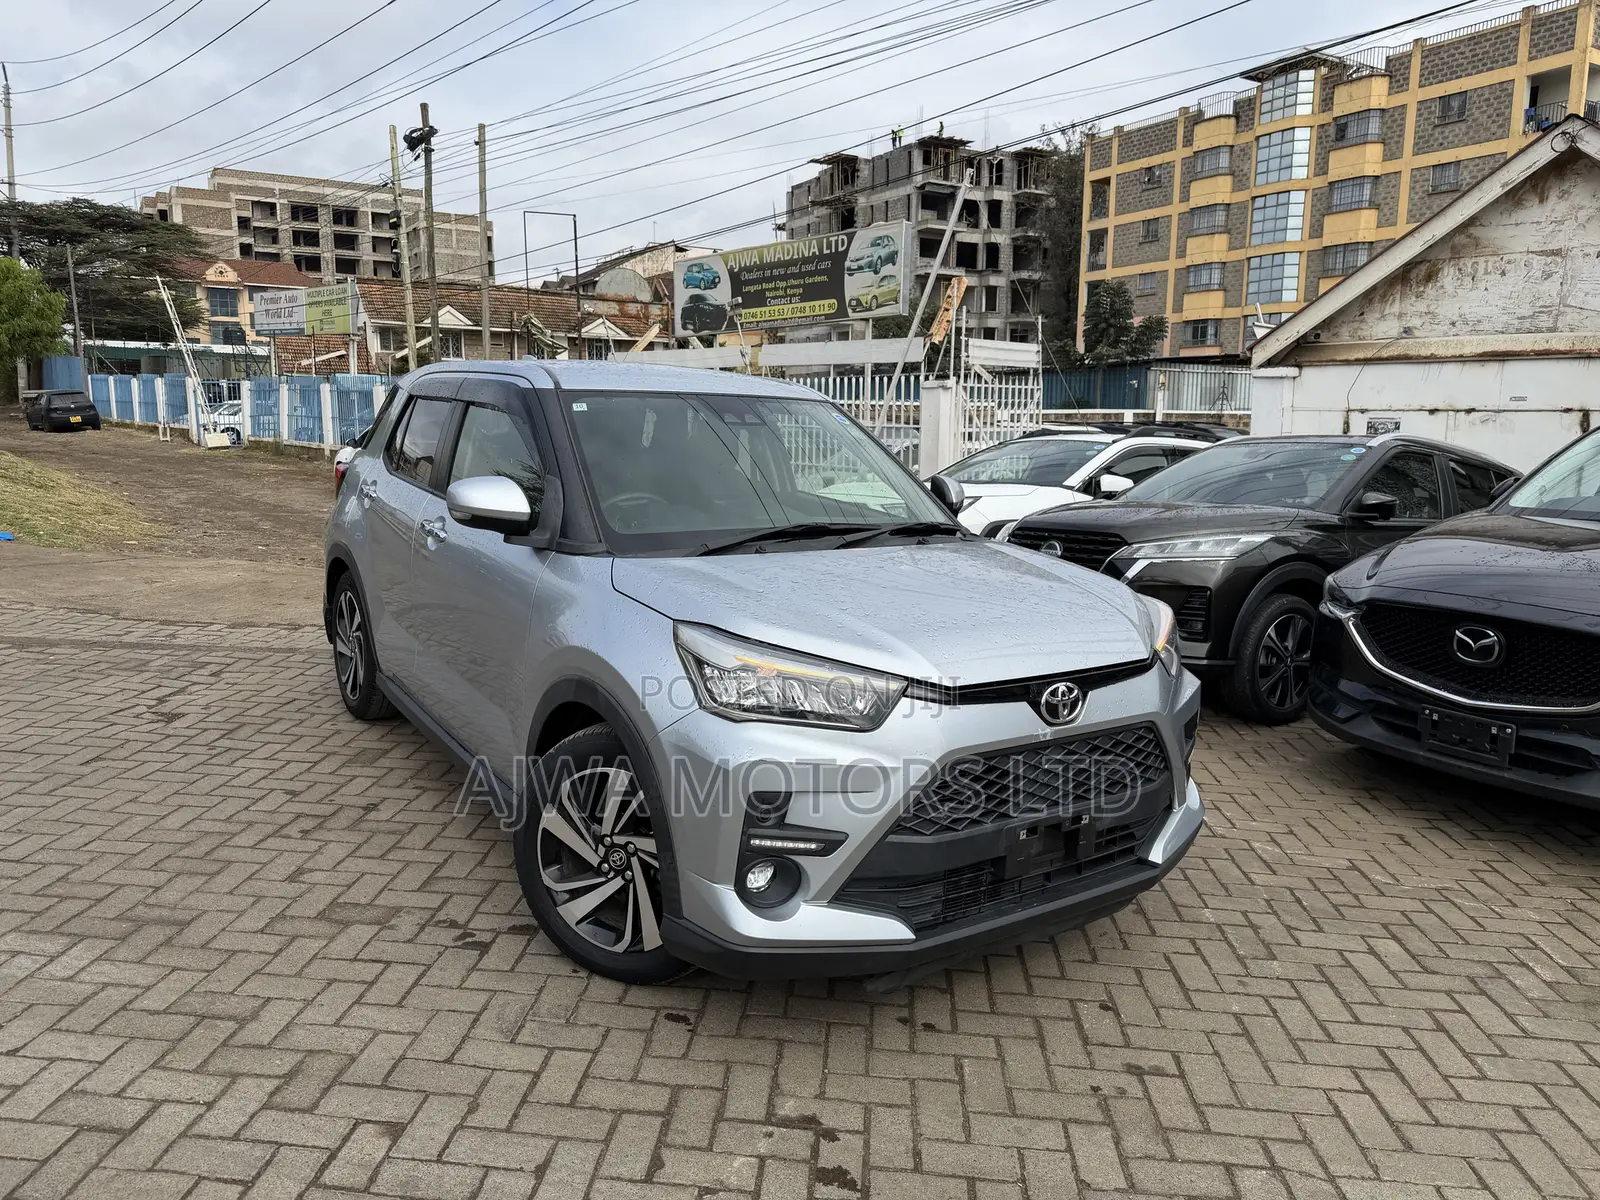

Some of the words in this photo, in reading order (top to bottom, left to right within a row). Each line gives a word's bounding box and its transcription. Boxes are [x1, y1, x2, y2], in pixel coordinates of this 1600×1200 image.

[727, 249, 760, 272] AJWA
[763, 240, 819, 264] MADINA
[823, 234, 848, 255] LTD
[740, 269, 764, 281] Dealers
[764, 268, 772, 277] in
[773, 268, 787, 276] new
[787, 262, 801, 273] and
[802, 259, 817, 270] used
[817, 260, 832, 269] cars
[306, 289, 326, 299] MULTIPLE
[326, 287, 335, 297] CAR
[335, 285, 348, 296] LOAN
[742, 284, 762, 294] Langata
[762, 281, 776, 290] Road
[786, 287, 803, 296] Kenya
[259, 294, 282, 305] Premier
[283, 293, 298, 304] Auto
[766, 297, 791, 306] Contact
[264, 308, 282, 319] World
[321, 308, 333, 317] HERE
[743, 309, 759, 321] 0746
[759, 309, 767, 319] 51
[768, 308, 776, 317] 53
[777, 306, 785, 317] 53
[790, 304, 807, 316] 0748
[808, 303, 817, 313] 10
[818, 303, 826, 311] 11
[827, 301, 837, 311] 90
